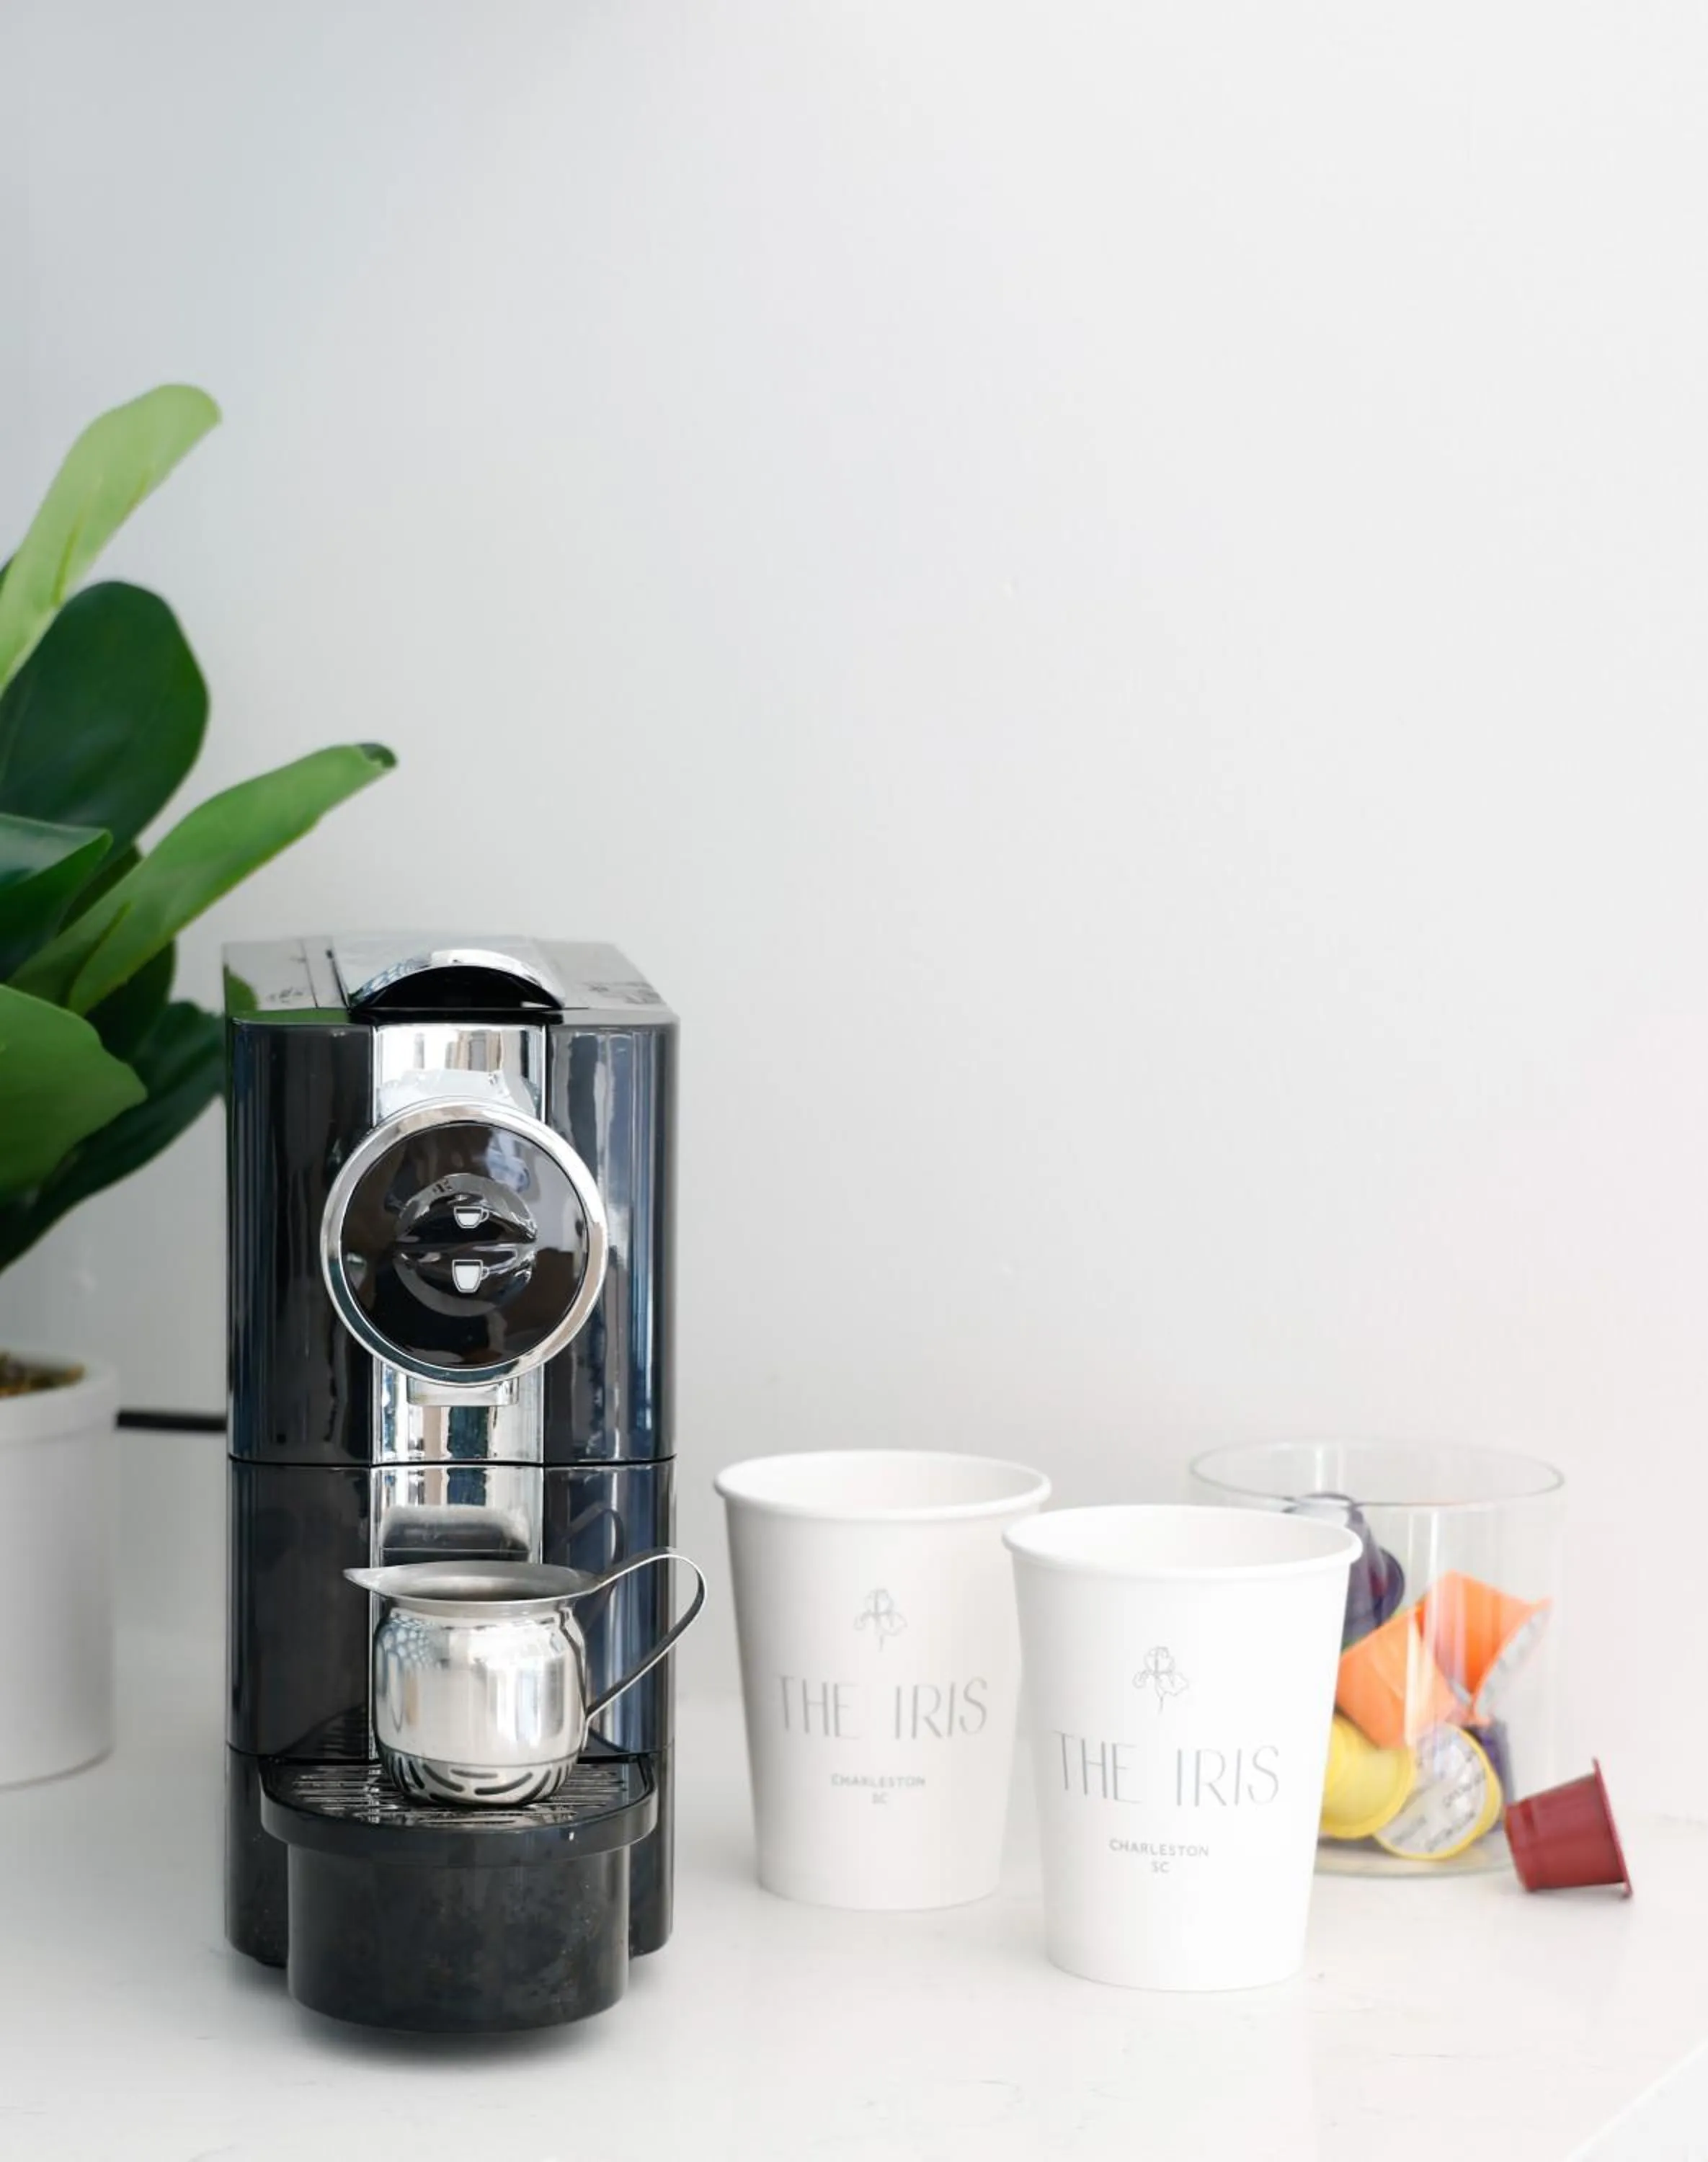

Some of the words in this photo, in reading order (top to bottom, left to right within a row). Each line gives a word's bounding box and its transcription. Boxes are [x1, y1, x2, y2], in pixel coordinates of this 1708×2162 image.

[775, 1674, 862, 1740] THE
[895, 1676, 988, 1740] IRIS
[1052, 1730, 1142, 1804] THE
[1176, 1745, 1279, 1807] IRIS
[830, 1773, 926, 1789] CHARLESTON
[871, 1792, 889, 1805] SC
[1108, 1838, 1209, 1857] CHARLESTON
[1152, 1861, 1170, 1874] SC
